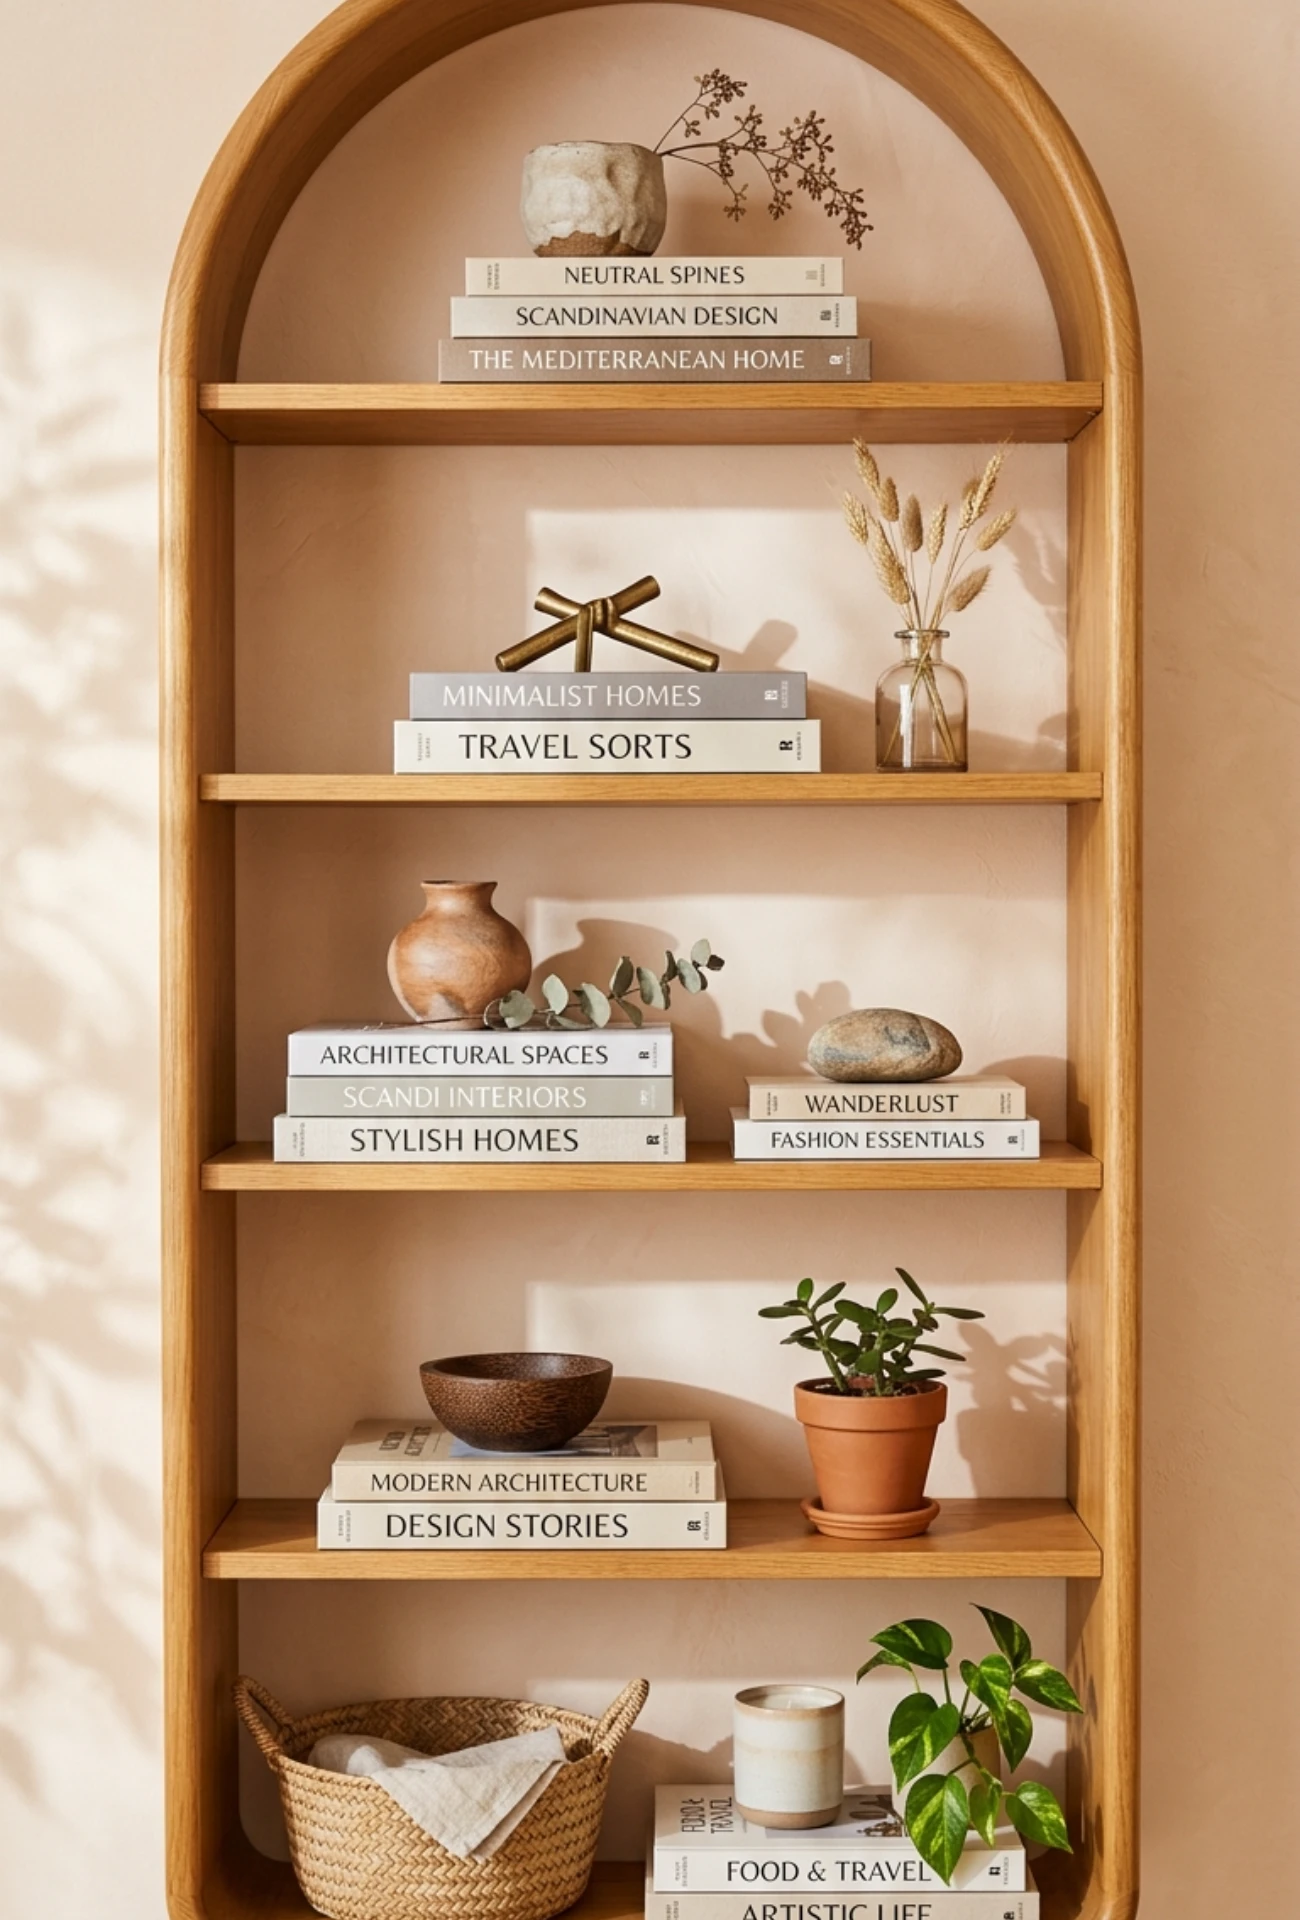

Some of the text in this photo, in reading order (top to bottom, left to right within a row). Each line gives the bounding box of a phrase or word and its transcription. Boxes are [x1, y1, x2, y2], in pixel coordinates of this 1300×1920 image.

[565, 265, 745, 285] NEUTRAL SPINES
[516, 306, 778, 326] SCANDINAVIAN DESIGN
[469, 349, 805, 370] THE MEDITERRANEAN HOME
[442, 685, 701, 707] MINIMALIST HOMES
[458, 734, 578, 760] TRAVEL
[589, 733, 692, 760] SORTS
[320, 1045, 609, 1065] ARCHITECTURAL SPACES
[343, 1086, 587, 1109] SCANDI INTERIORS
[804, 1094, 959, 1114] WANDERLUST
[350, 1128, 579, 1152] STYLISH HOMES
[771, 1130, 985, 1149] FASHION ESSENTIALS
[371, 1472, 647, 1493] MODERN ARCHITECTURE
[386, 1513, 629, 1538] DESIGN STORIES
[727, 1860, 932, 1882] FOOD & TRAVEL
[741, 1903, 868, 1920] ARTISTIC
